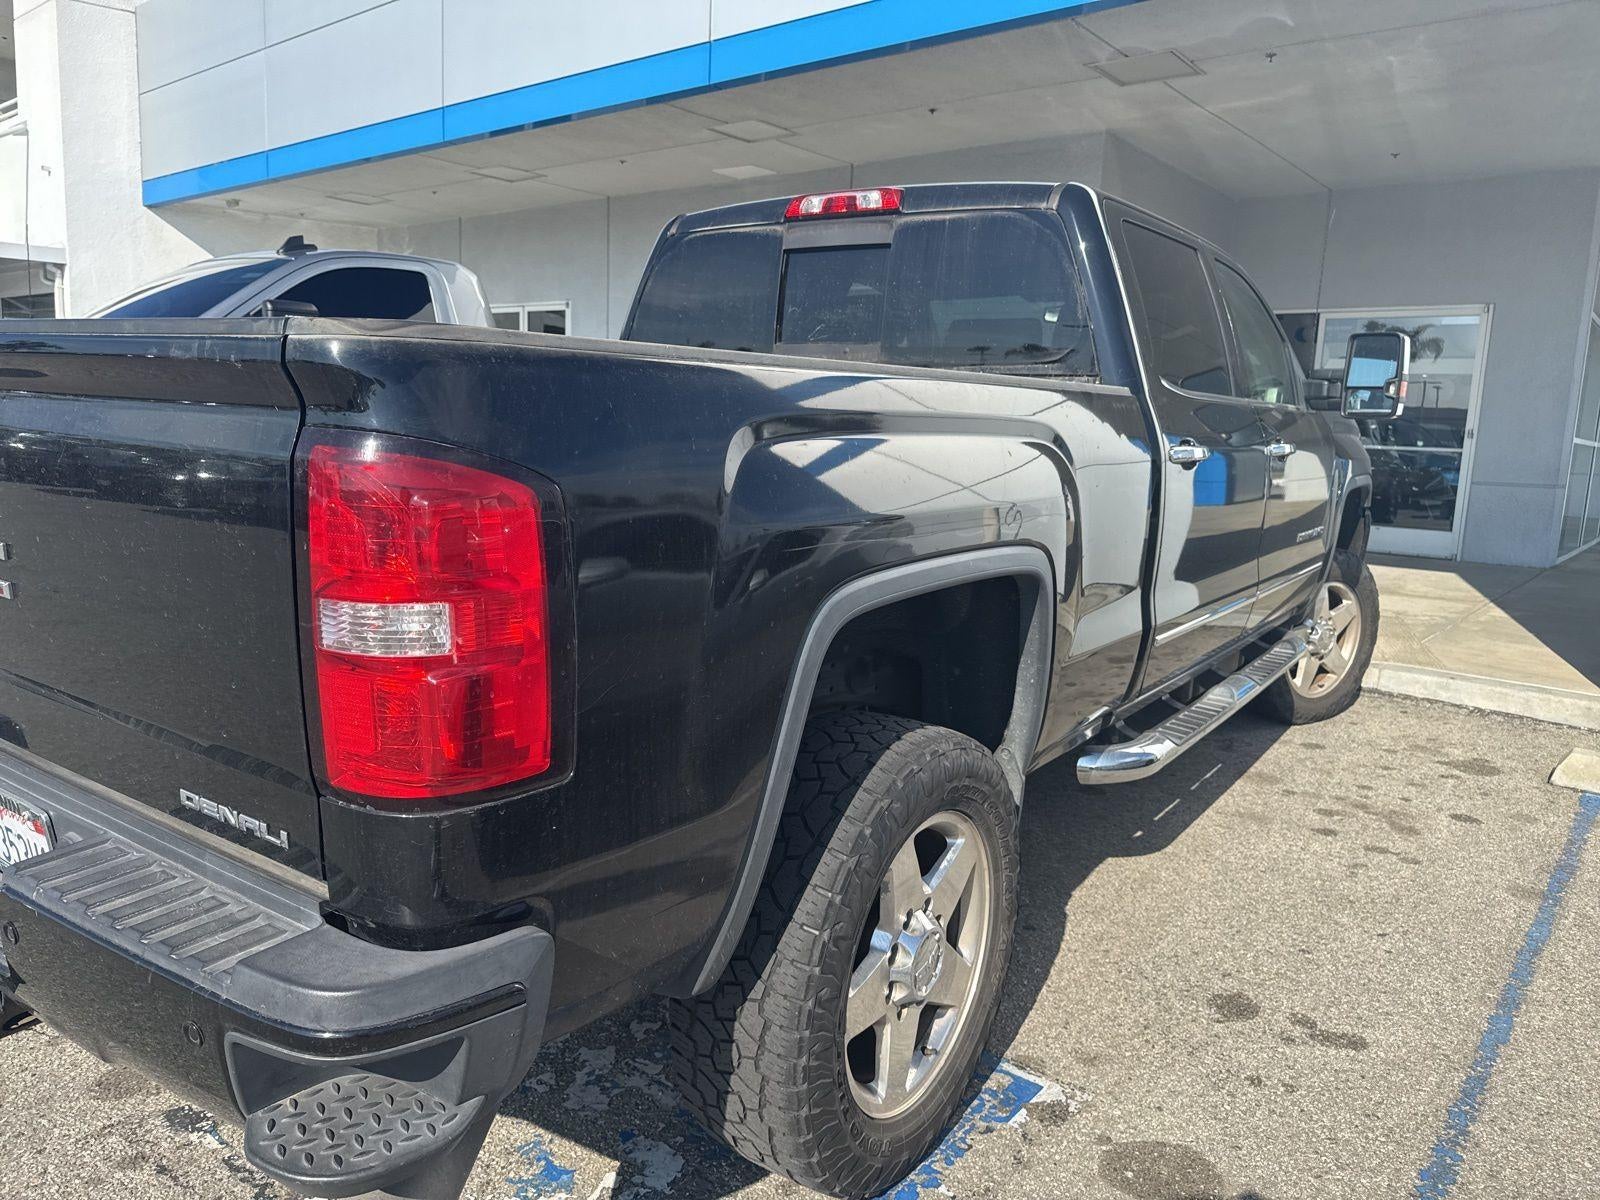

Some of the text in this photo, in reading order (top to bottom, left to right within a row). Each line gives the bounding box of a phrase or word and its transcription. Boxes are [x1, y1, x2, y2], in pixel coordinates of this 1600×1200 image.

[180, 788, 289, 850] DENALI
[983, 800, 1019, 912] COUNTRY
[849, 1119, 893, 1158] TOYO
